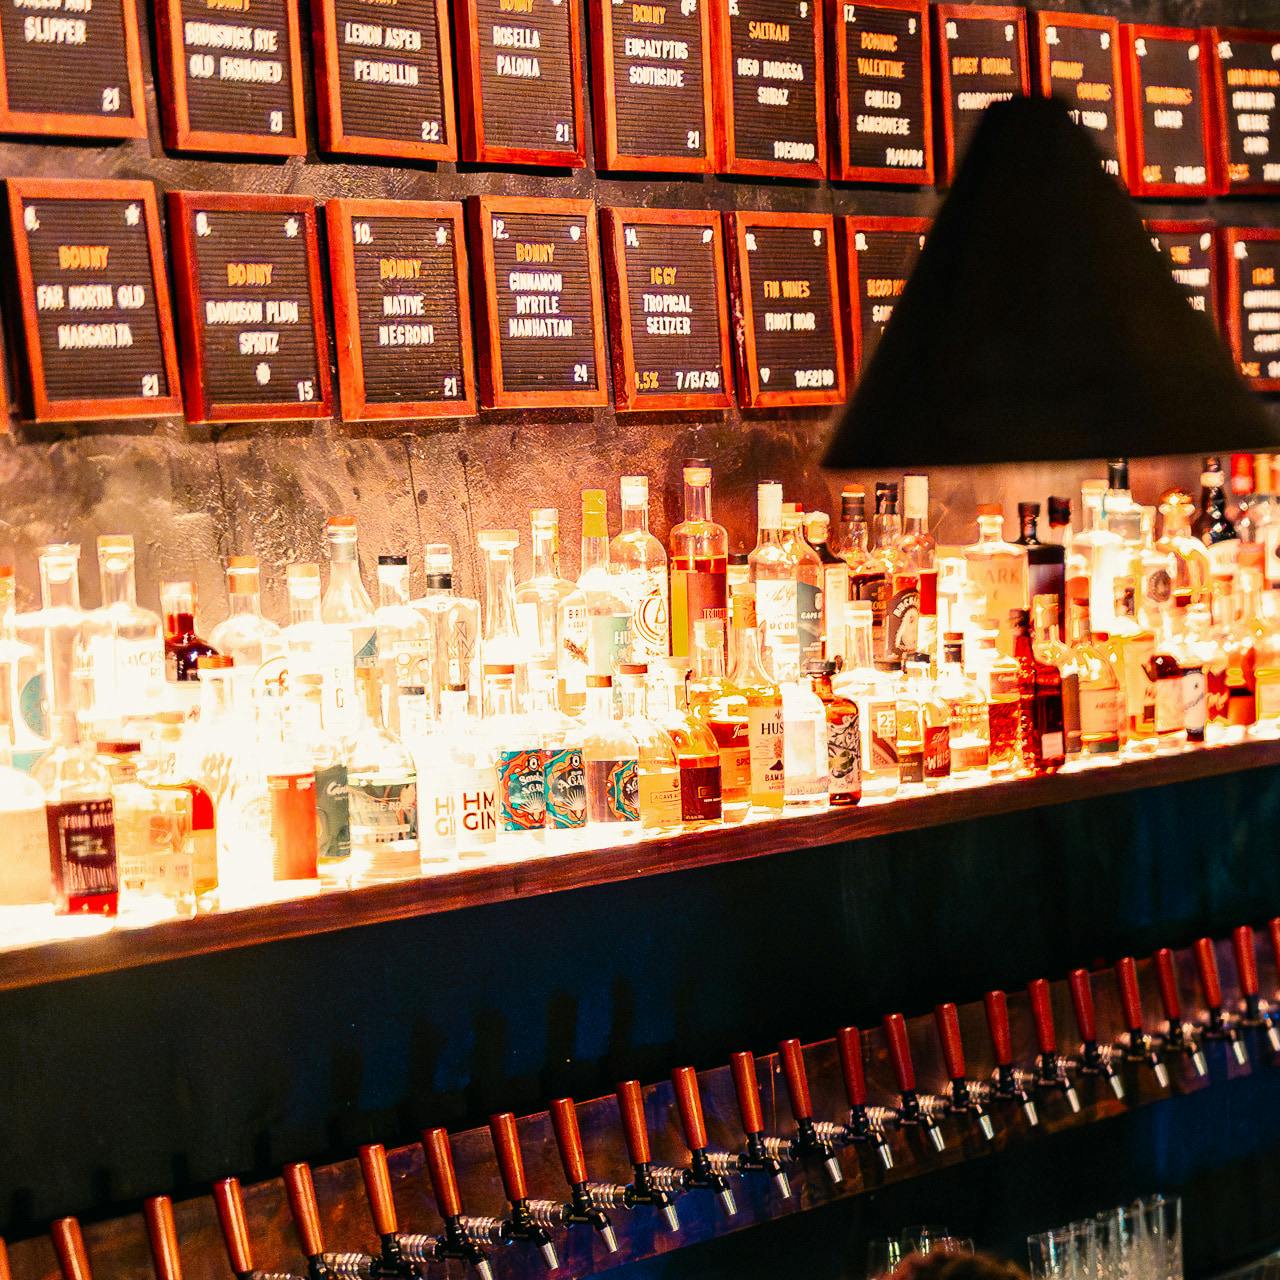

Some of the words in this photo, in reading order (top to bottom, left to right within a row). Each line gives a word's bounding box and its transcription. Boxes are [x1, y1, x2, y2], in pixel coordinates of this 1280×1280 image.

[24, 16, 87, 44] SLIPPER
[184, 21, 252, 50] BRUNSWICK
[253, 28, 278, 52] RYE
[344, 22, 382, 47] LEMON
[383, 27, 422, 51] ASPEN
[493, 25, 541, 49] ROSELLA
[625, 37, 689, 60] EUCALYPTUS
[189, 54, 213, 79] OLD
[219, 57, 282, 84] FASHIONED
[354, 59, 418, 86] PENICILLIN
[496, 54, 541, 78] PALOMA
[629, 66, 685, 88] SOUTHSIDE
[857, 58, 905, 78] VALENTINE
[102, 87, 120, 111] 21
[421, 121, 439, 141] 22
[555, 123, 569, 142] 21
[687, 130, 700, 149] 21
[509, 271, 562, 292] CINNAMON
[36, 285, 63, 310] FAR
[69, 285, 112, 310] NORTH
[117, 285, 145, 309] OLD
[383, 294, 425, 316] NATIVE
[516, 295, 560, 315] MYRTLE
[643, 294, 692, 313] TROPICAL
[206, 301, 263, 325] DAVIDSON
[265, 301, 299, 324] PLUM
[58, 324, 133, 349] MARGARITA
[379, 324, 434, 346] NEGRONI
[509, 318, 573, 338] MANHATTAN
[646, 316, 691, 335] SELTZER
[238, 331, 279, 355] SPRITZ
[574, 364, 588, 382] 24
[141, 374, 159, 397] 21
[297, 381, 314, 401] 15
[444, 377, 458, 396] 21
[761, 722, 785, 735] HUS
[736, 757, 750, 767] SPIC
[520, 782, 545, 794] AGA
[463, 811, 497, 831] GIN
